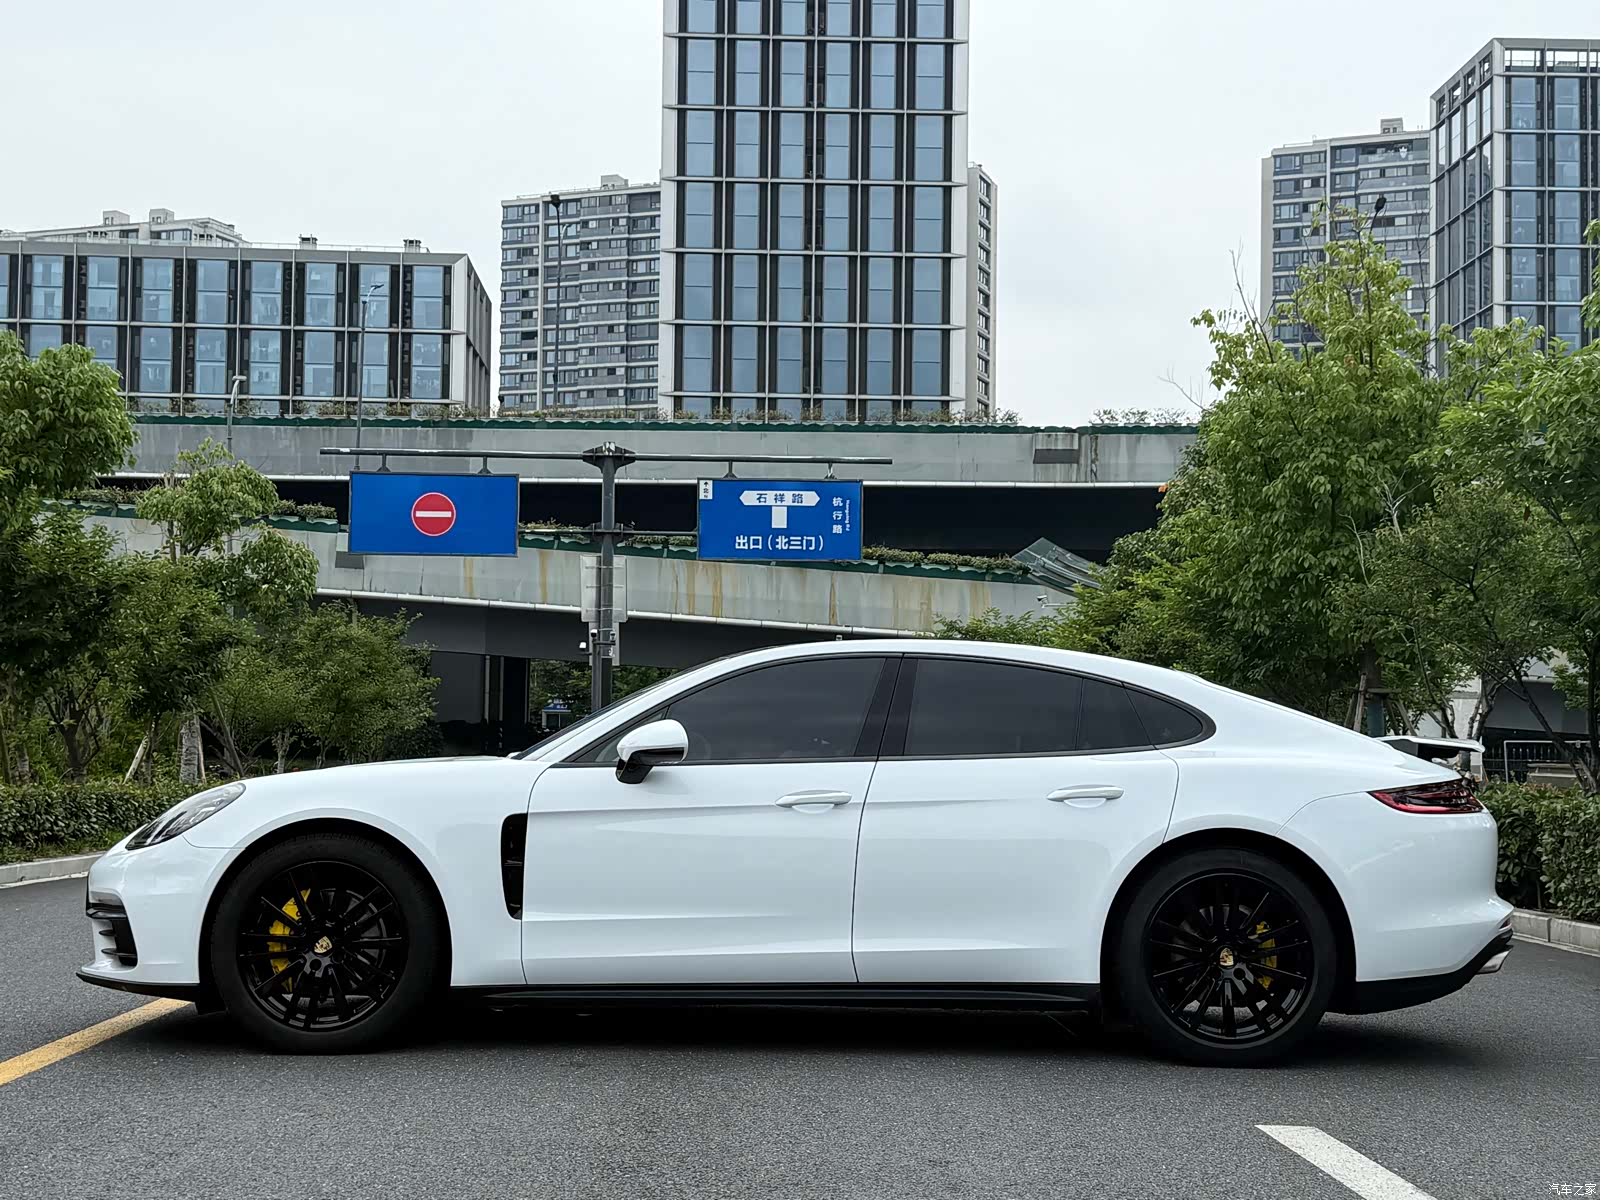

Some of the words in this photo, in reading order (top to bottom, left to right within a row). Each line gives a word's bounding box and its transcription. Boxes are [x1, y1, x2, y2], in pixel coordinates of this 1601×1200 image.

[756, 493, 804, 504] 石祥路
[832, 497, 843, 534] 杭行路
[735, 535, 824, 551] 出口（北三门）
